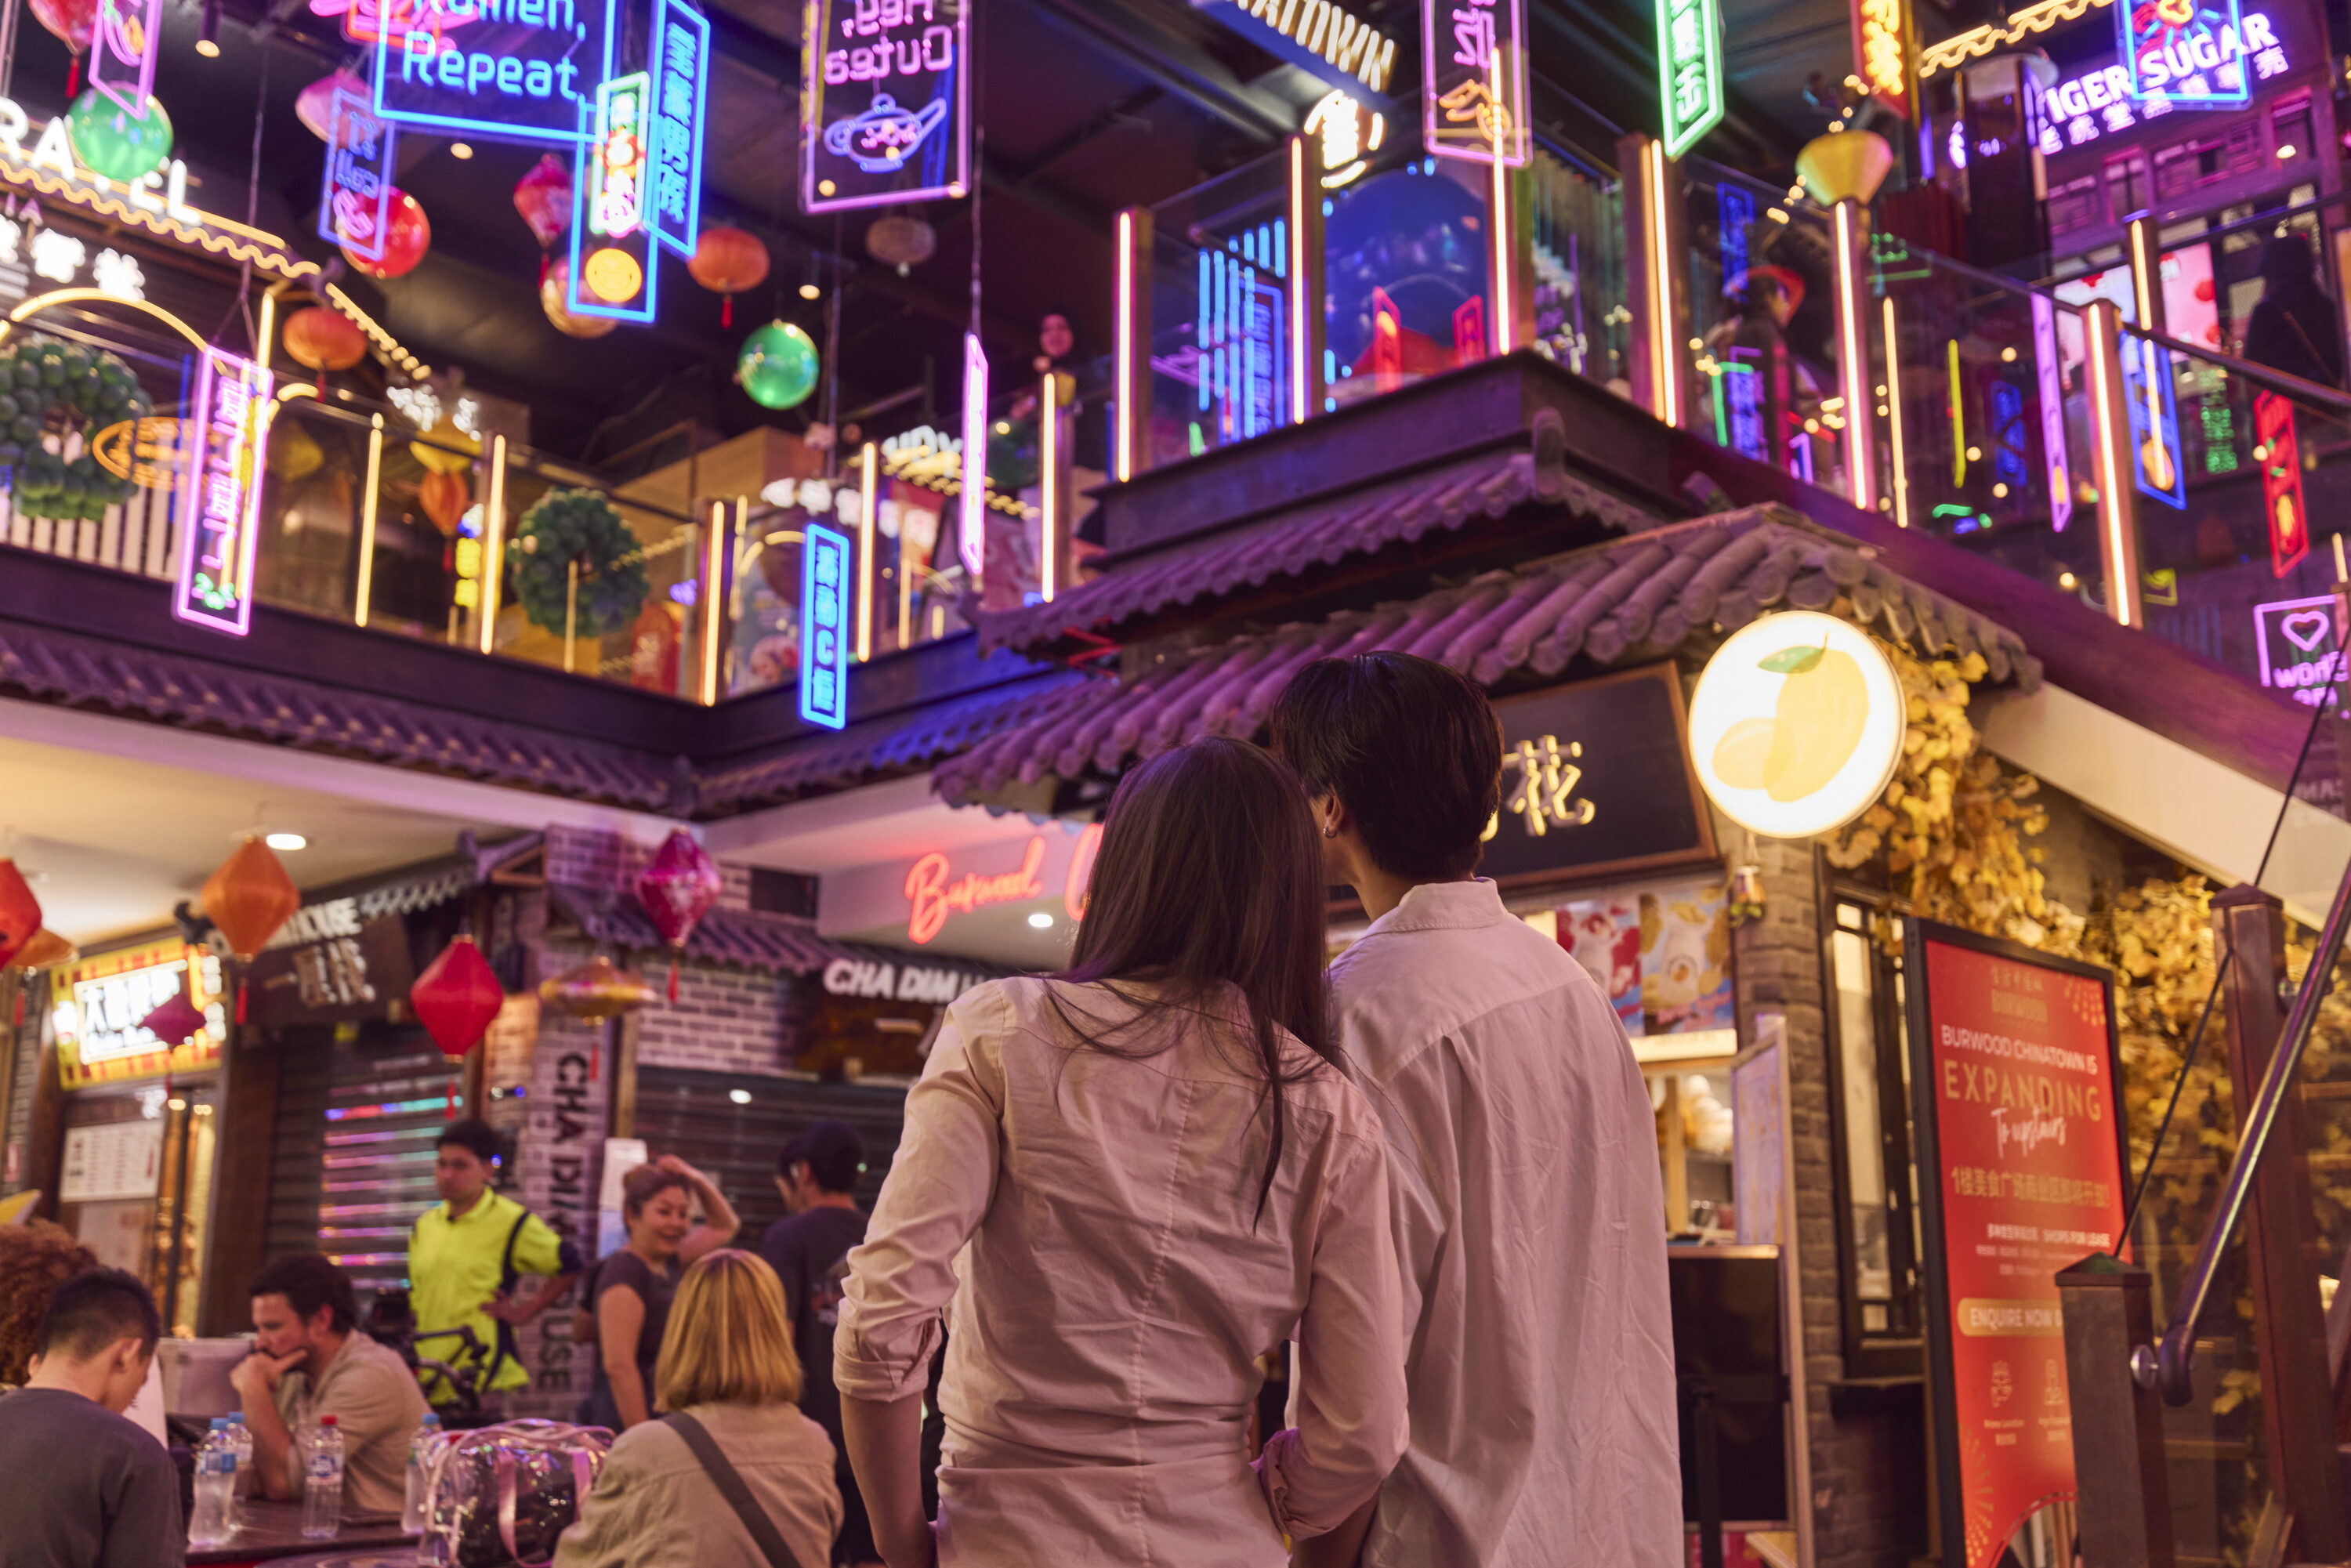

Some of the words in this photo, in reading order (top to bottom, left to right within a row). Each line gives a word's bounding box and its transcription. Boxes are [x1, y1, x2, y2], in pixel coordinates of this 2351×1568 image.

[402, 30, 579, 101] Repeat
[2040, 64, 2134, 125] IGER
[2139, 13, 2280, 89] SUGAR
[0, 96, 204, 227] RAEL
[824, 957, 896, 1000] CHA
[897, 965, 959, 1005] DIM
[1941, 1024, 2012, 1058] BURWOOD
[2013, 1039, 2085, 1073] CHINATOWN
[2086, 1055, 2099, 1076] IS
[553, 1052, 588, 1144] CHA
[1943, 1059, 2102, 1122] EXPANDING
[1970, 1307, 2023, 1331] ENQUIRE
[2024, 1309, 2052, 1327] NOW
